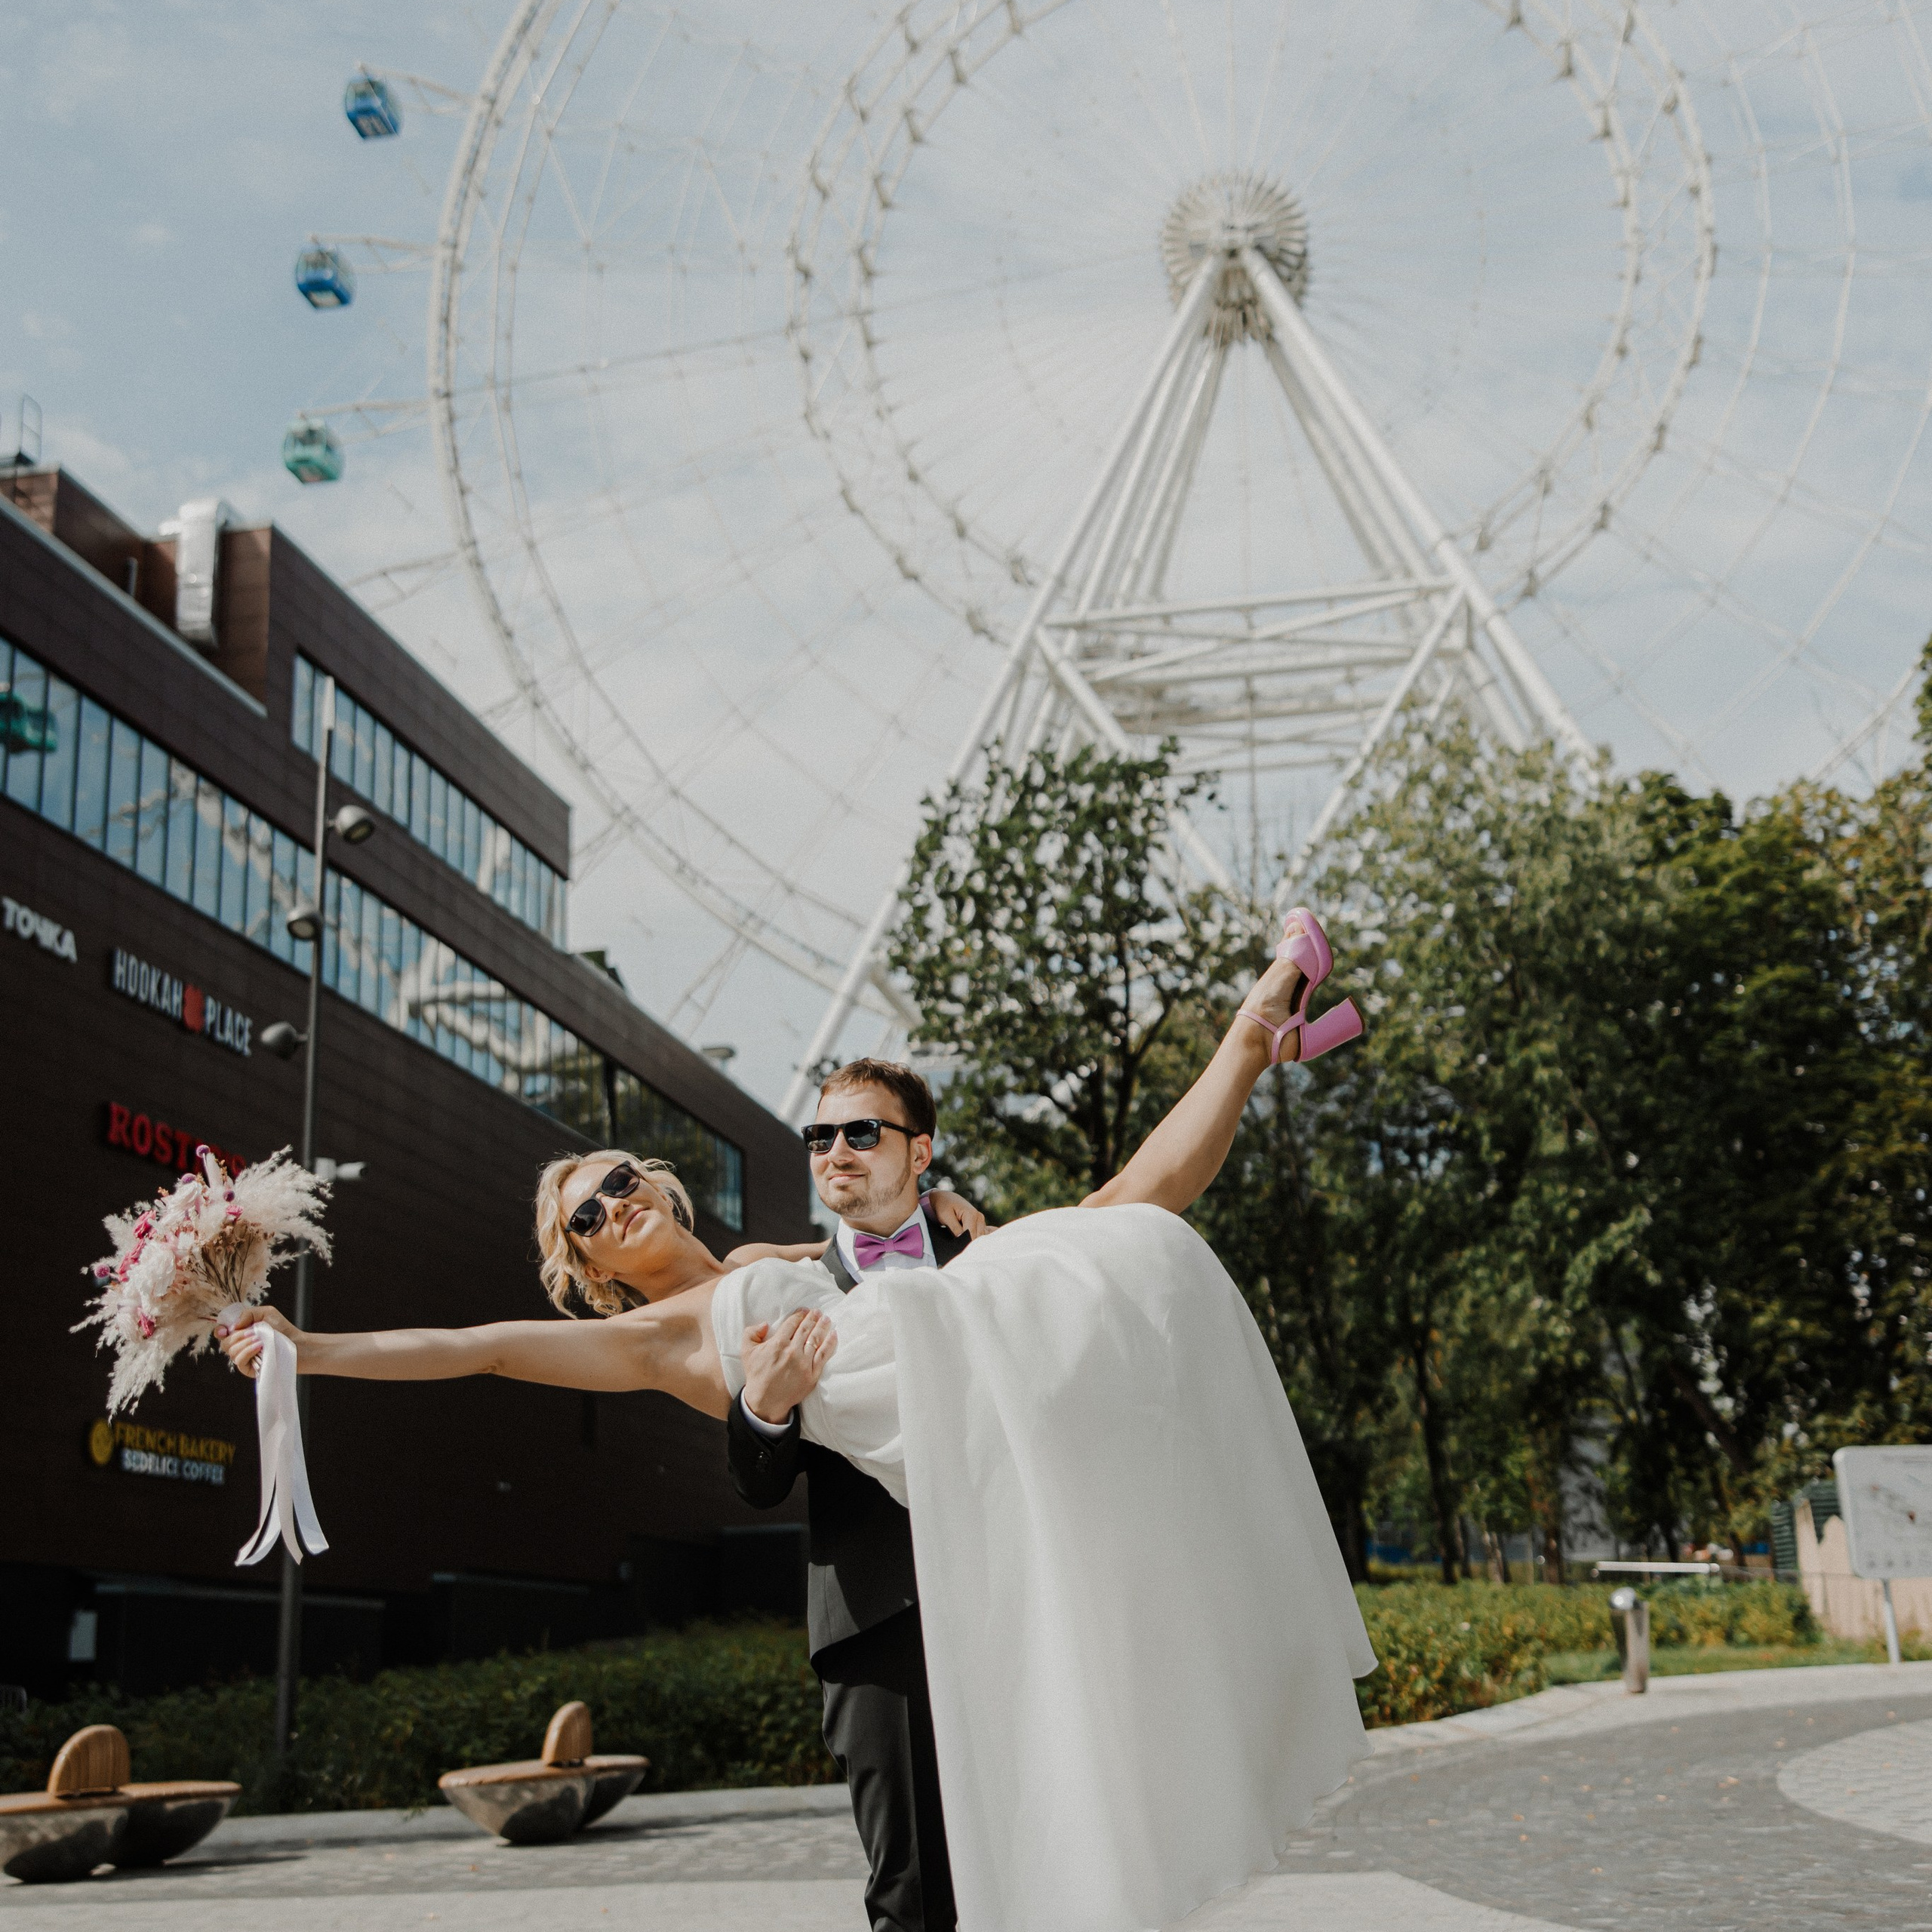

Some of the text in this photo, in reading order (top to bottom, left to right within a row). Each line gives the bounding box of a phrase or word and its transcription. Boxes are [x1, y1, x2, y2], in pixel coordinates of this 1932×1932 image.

[114, 948, 253, 1056] HOOKAH PLACE
[179, 1432, 235, 1464] BAKERY
[182, 1460, 225, 1484] COFFEE
